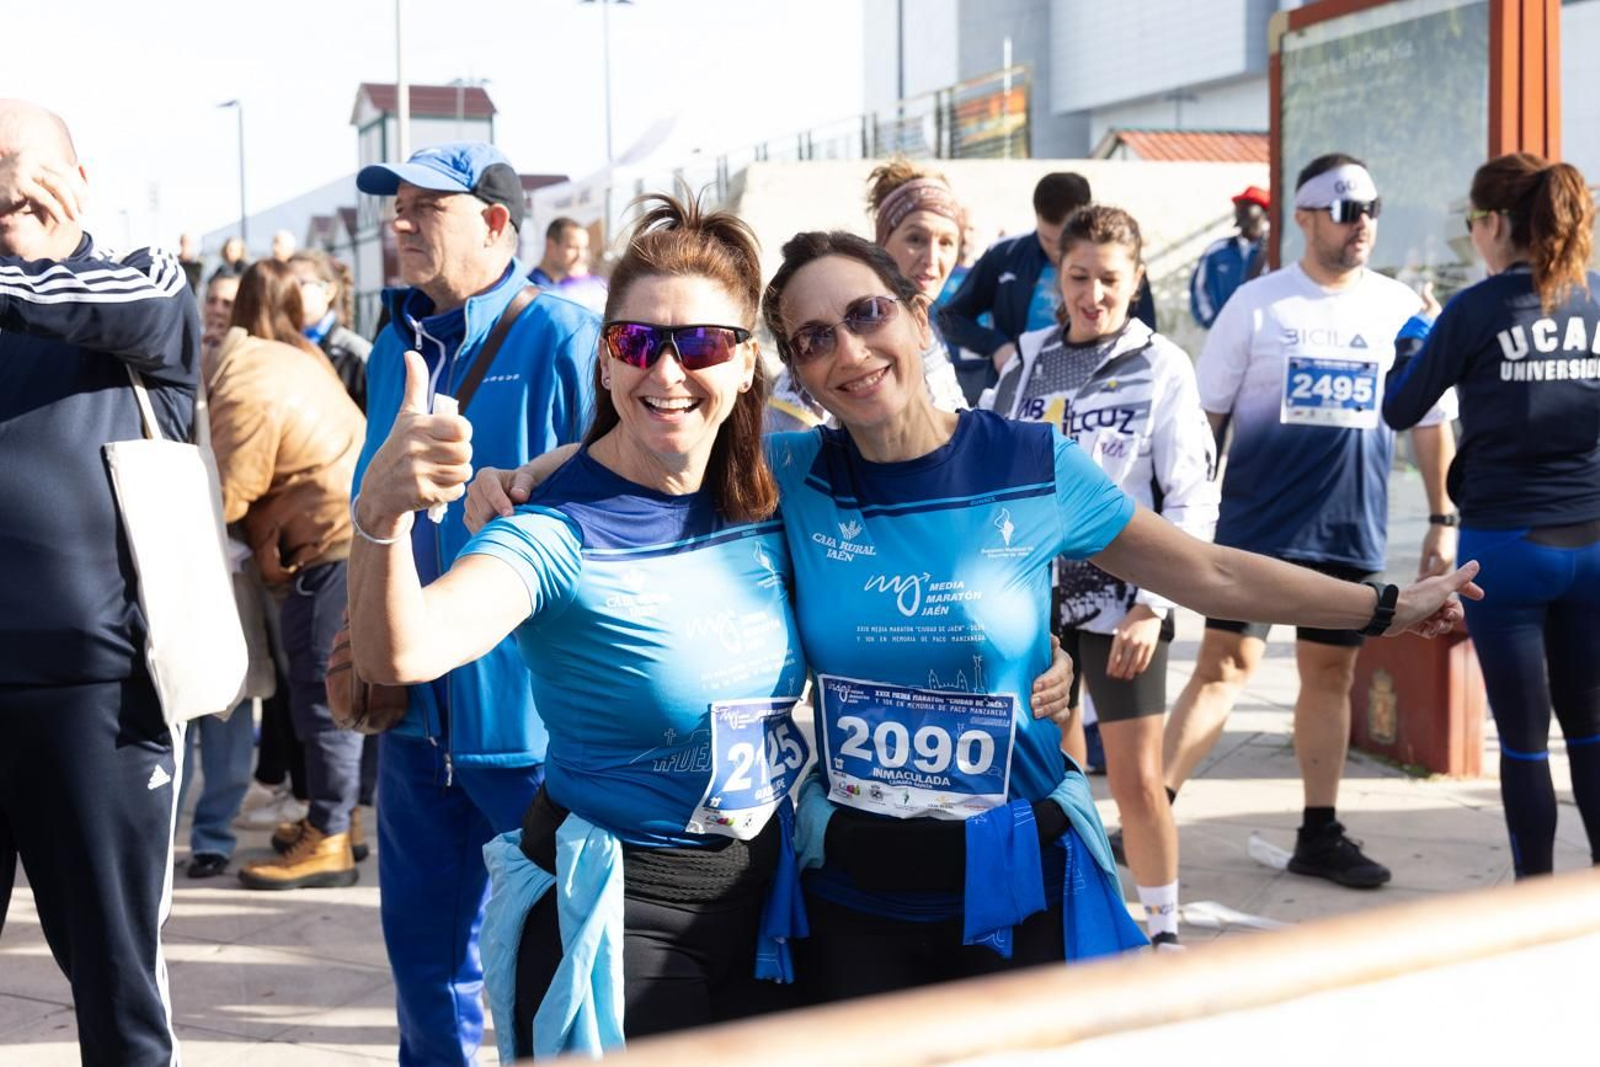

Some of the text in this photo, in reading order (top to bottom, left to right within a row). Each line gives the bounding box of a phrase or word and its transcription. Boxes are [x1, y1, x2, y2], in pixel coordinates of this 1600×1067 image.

[1500, 358, 1600, 382] UNIVERSID
[1291, 373, 1373, 403] 2495
[812, 532, 877, 556] CAJA RURAL
[826, 548, 855, 562] JAÉN
[928, 580, 965, 591] MEDIA
[925, 590, 982, 604] MARATÓN
[921, 604, 950, 617] JAÉN
[870, 625, 888, 633] MEDIA
[938, 625, 946, 633] DE
[879, 635, 887, 643] EN
[891, 635, 916, 643] MEMORIA
[920, 635, 928, 643] DE
[932, 635, 947, 643] PACO
[874, 690, 891, 698] XXIX
[891, 691, 911, 702] MEDIA
[975, 699, 984, 707] DE
[882, 698, 893, 706] 10K
[896, 700, 904, 708] EN
[906, 702, 935, 711] MEMORIA
[938, 704, 946, 712] DE
[969, 707, 1008, 717] MANZANEDA
[836, 715, 995, 775] 2090
[872, 767, 951, 786] INMACULADA
